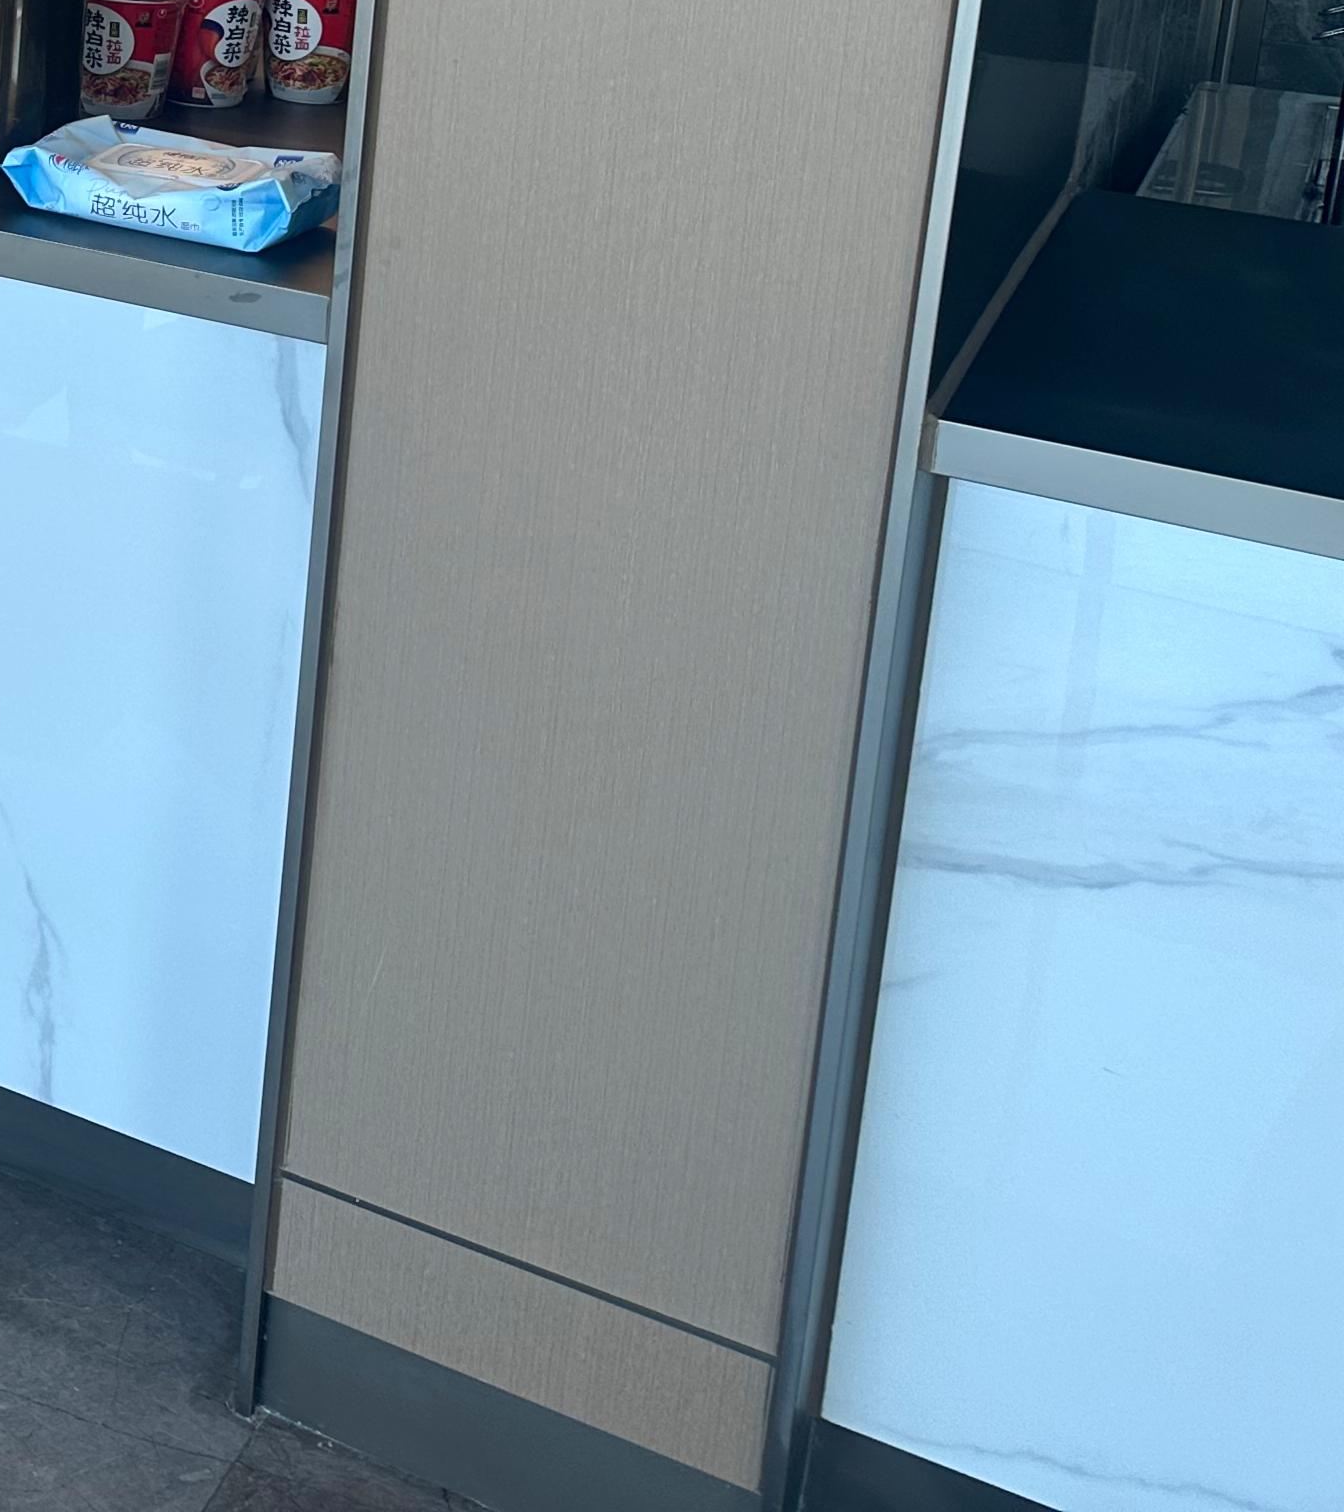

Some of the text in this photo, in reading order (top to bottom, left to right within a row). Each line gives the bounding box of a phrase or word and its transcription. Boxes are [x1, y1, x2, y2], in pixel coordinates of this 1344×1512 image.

[85, 9, 106, 69] 辣白菜
[106, 39, 123, 65] 拉面
[222, 3, 250, 64] 辣白菜
[294, 25, 312, 51] 拉面
